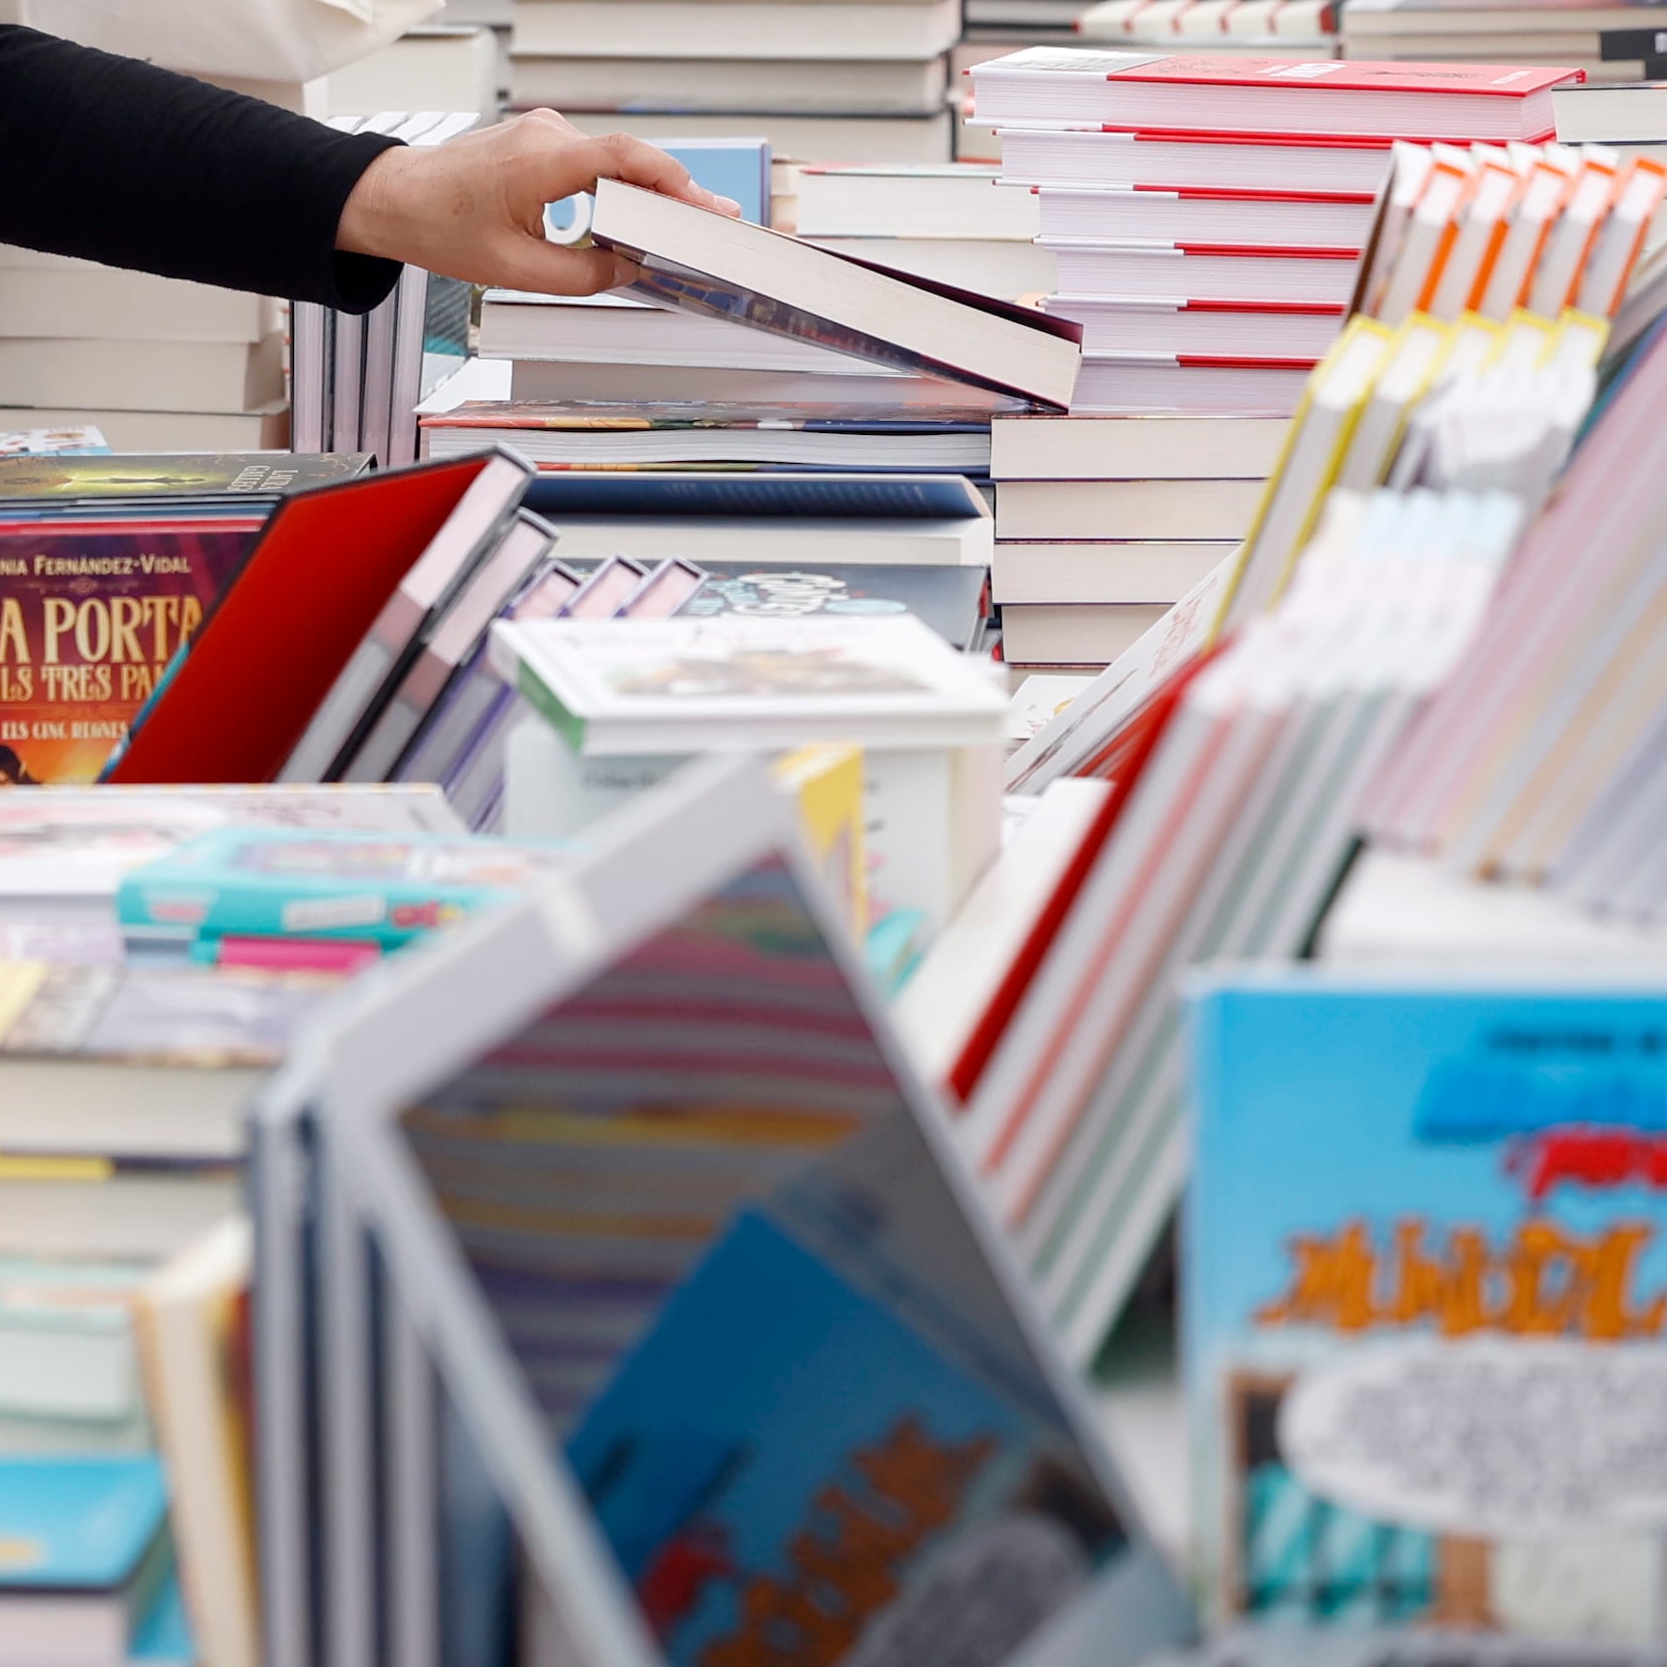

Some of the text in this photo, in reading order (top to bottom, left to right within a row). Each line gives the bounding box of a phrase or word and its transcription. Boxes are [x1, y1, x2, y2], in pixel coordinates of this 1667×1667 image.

[43, 595, 203, 663] PORTA
[41, 664, 113, 702] TRES
[121, 664, 165, 702] PA
